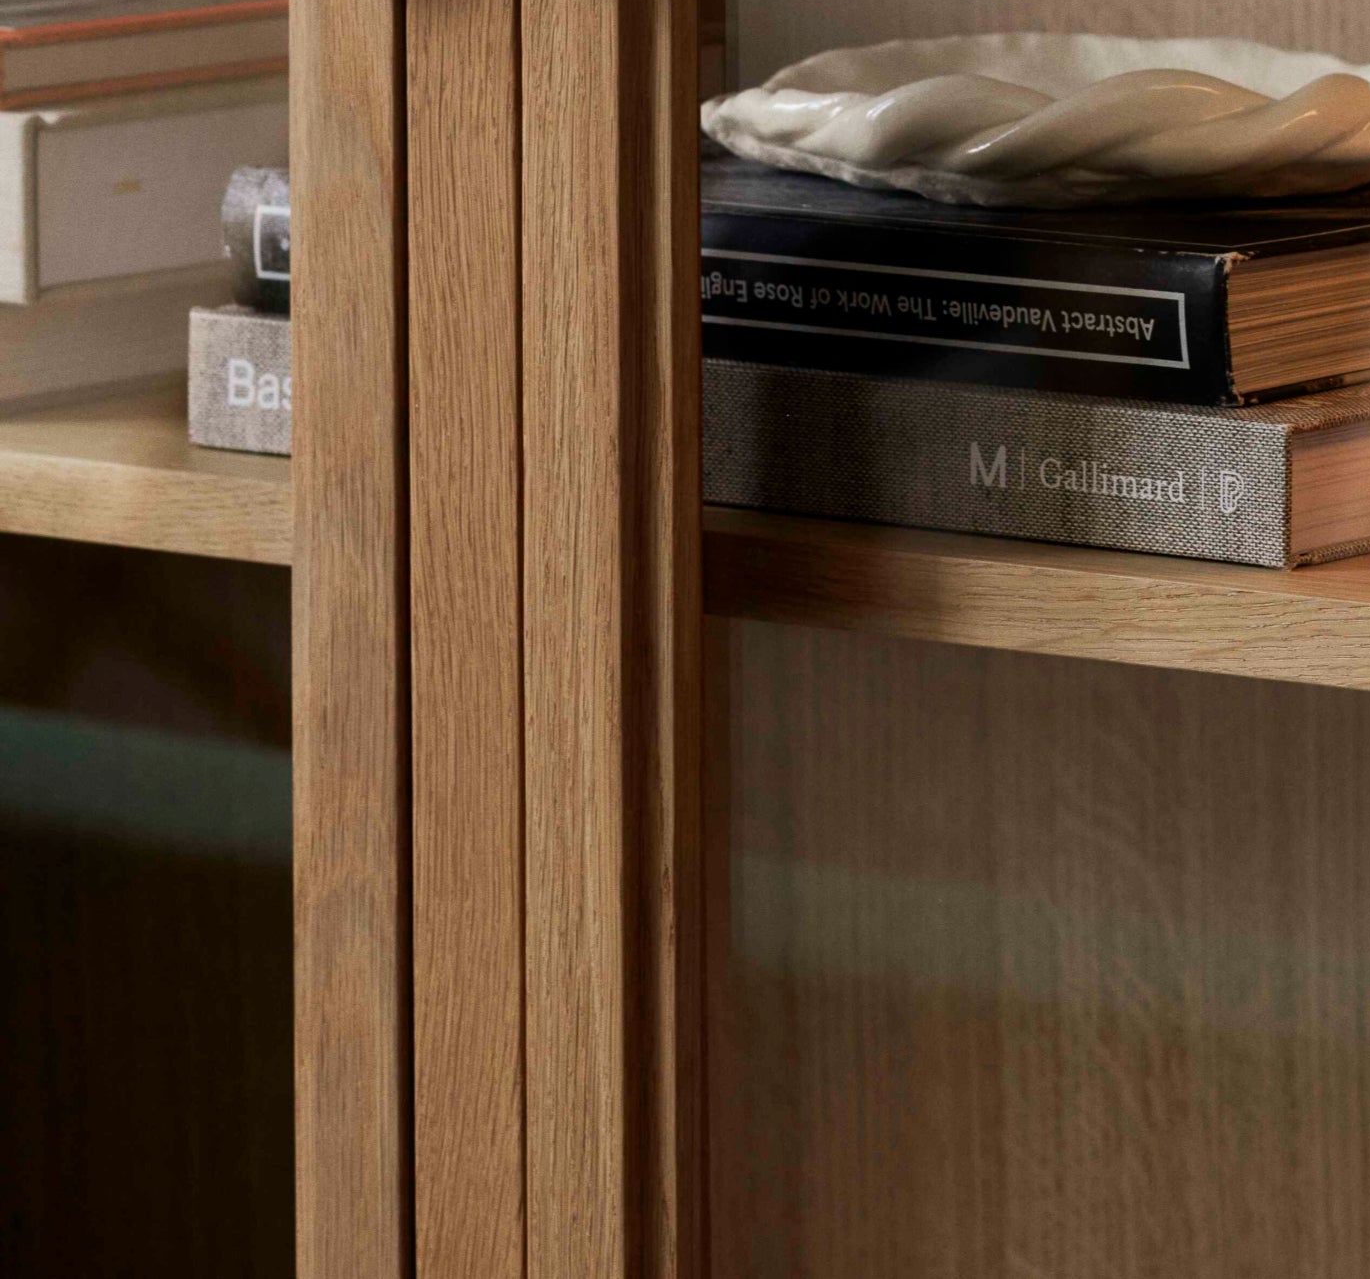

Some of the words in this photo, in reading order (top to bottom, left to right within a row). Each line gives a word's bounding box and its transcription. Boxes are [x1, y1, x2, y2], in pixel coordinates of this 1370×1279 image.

[701, 271, 748, 303] Engli
[753, 281, 804, 308] Rose
[809, 287, 831, 310] of
[836, 289, 893, 317] Work
[898, 295, 938, 321] The
[942, 300, 1057, 333] Vaudeville:
[1060, 309, 1155, 341] Abstract
[969, 442, 1007, 488] M
[1039, 457, 1186, 504] Gallimard
